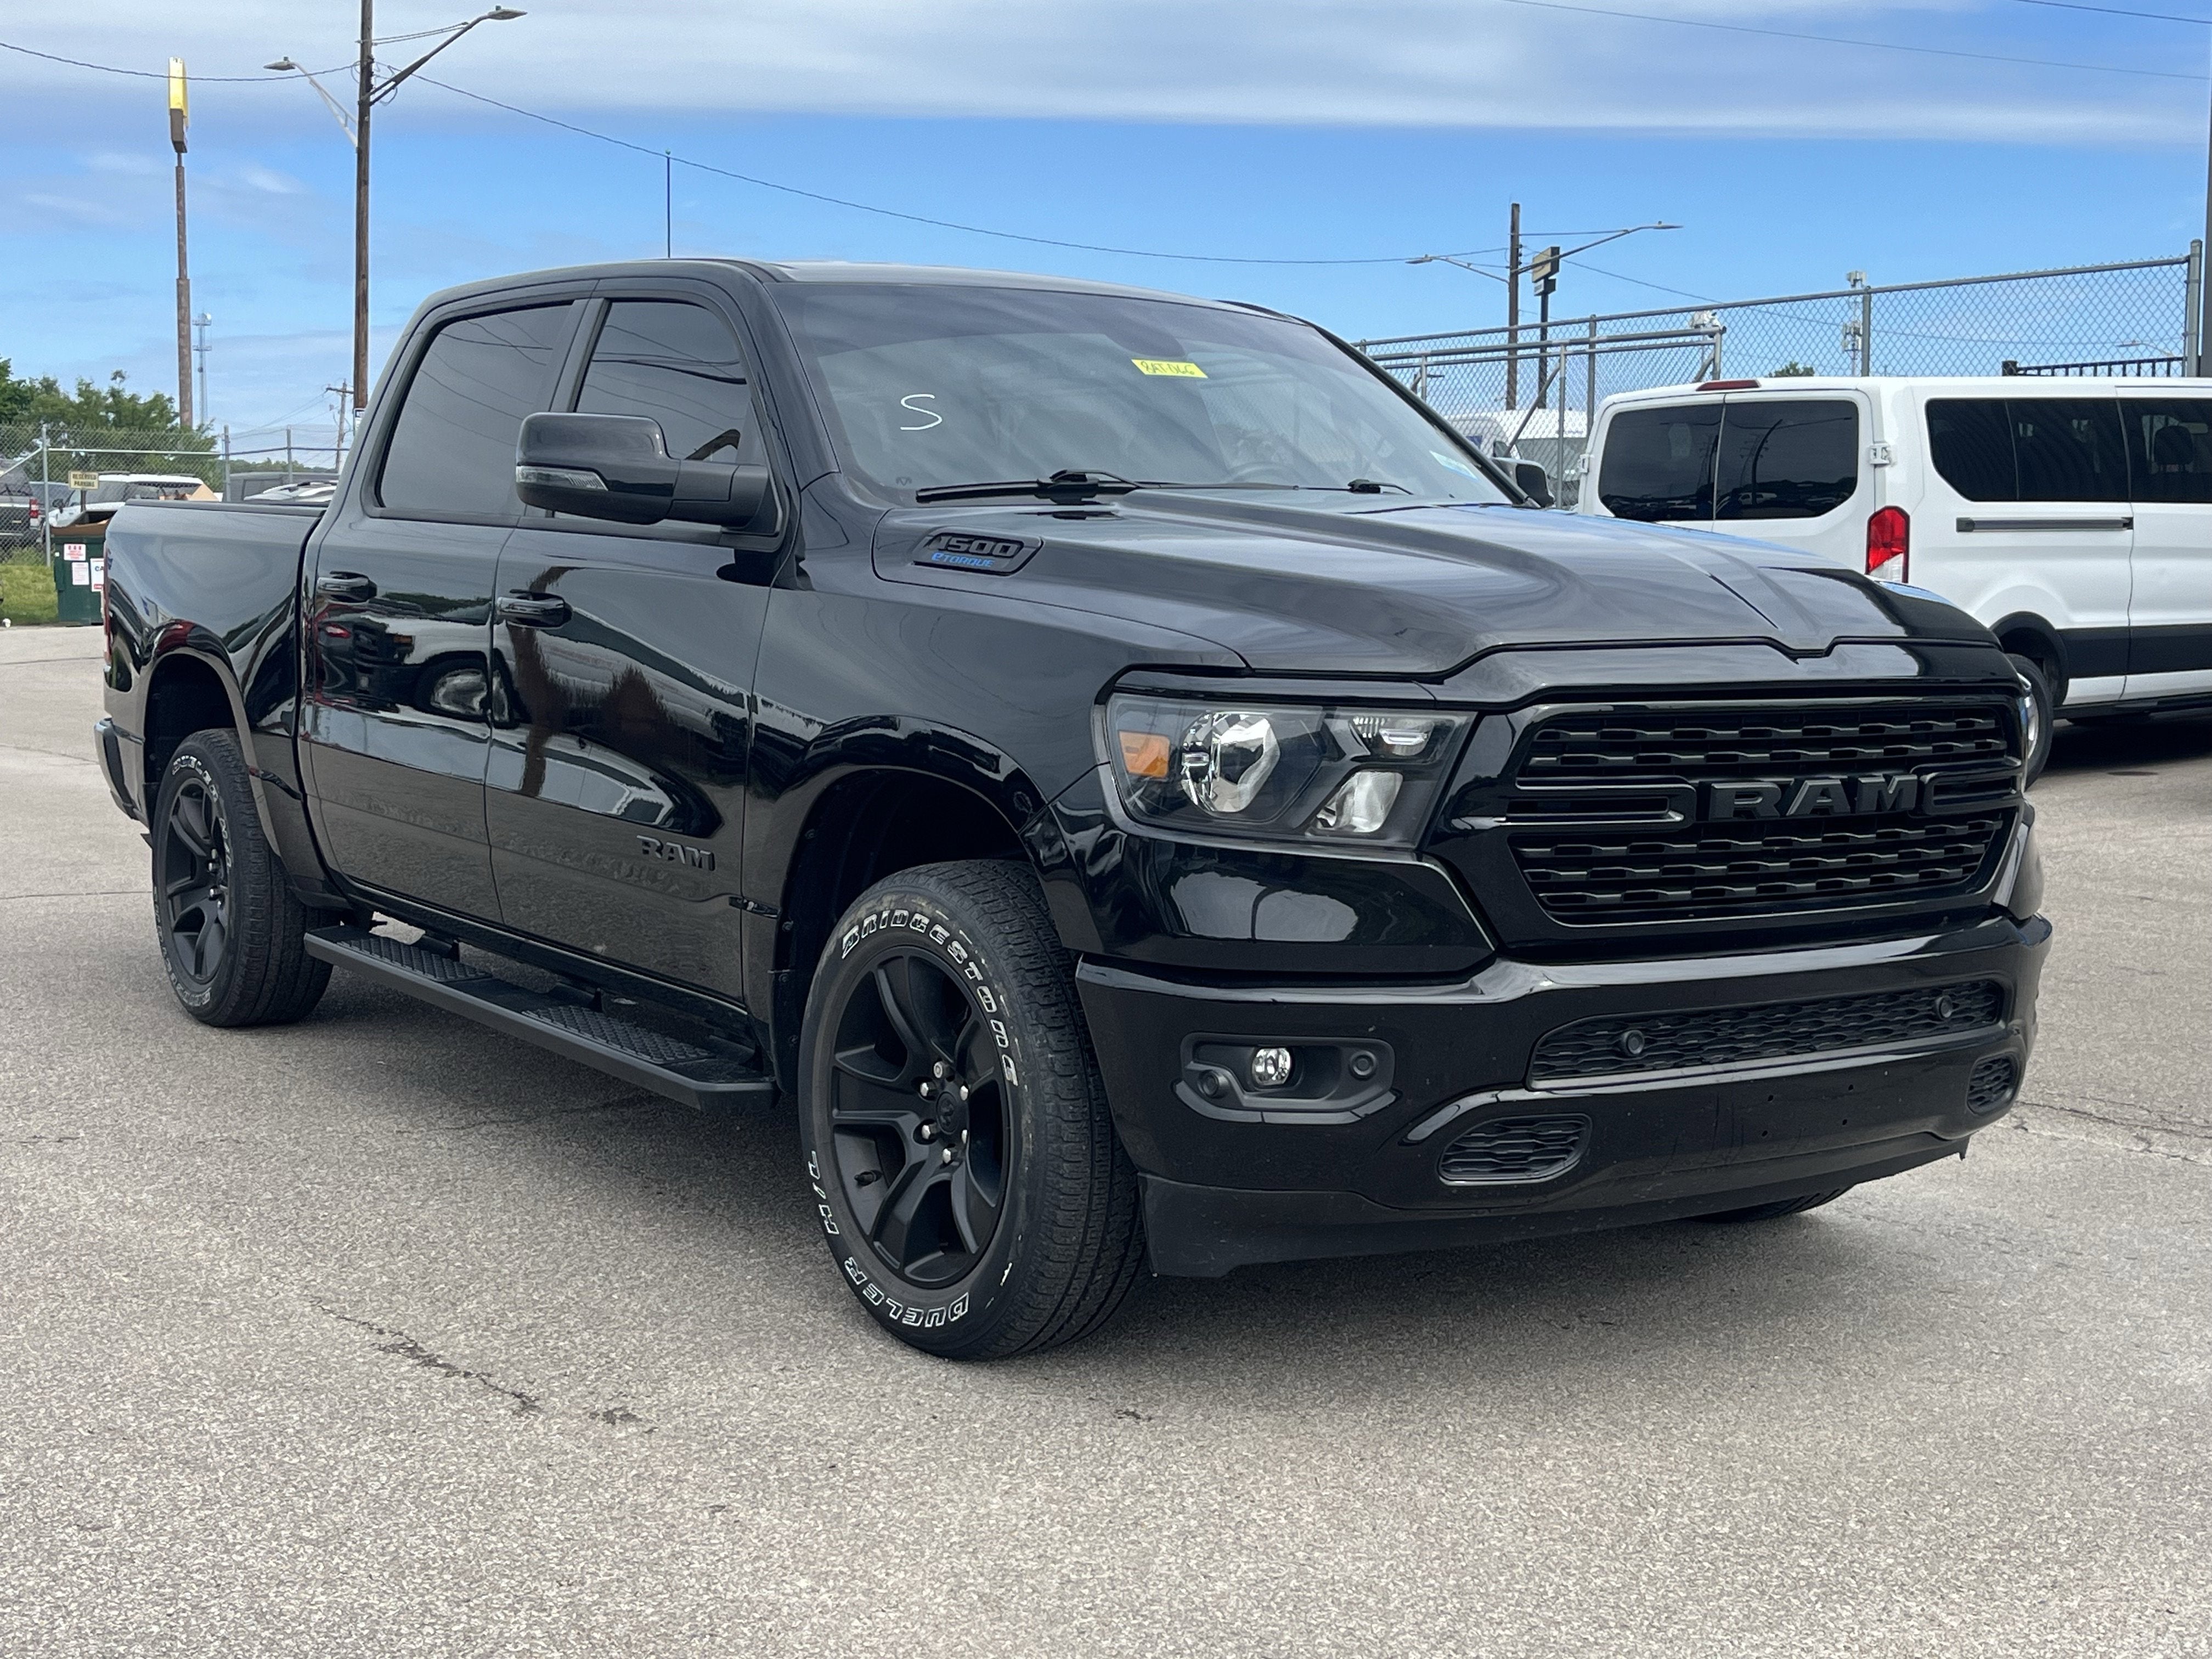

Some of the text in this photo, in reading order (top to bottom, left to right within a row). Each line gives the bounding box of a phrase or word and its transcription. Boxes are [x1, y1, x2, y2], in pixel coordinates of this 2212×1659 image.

[900, 393, 943, 431] S
[934, 535, 1019, 557] 1500
[1709, 774, 1919, 820] RAM
[636, 834, 715, 871] RAM
[841, 909, 1019, 1086] BRIDGESTONE
[844, 1256, 969, 1328] DUELER
